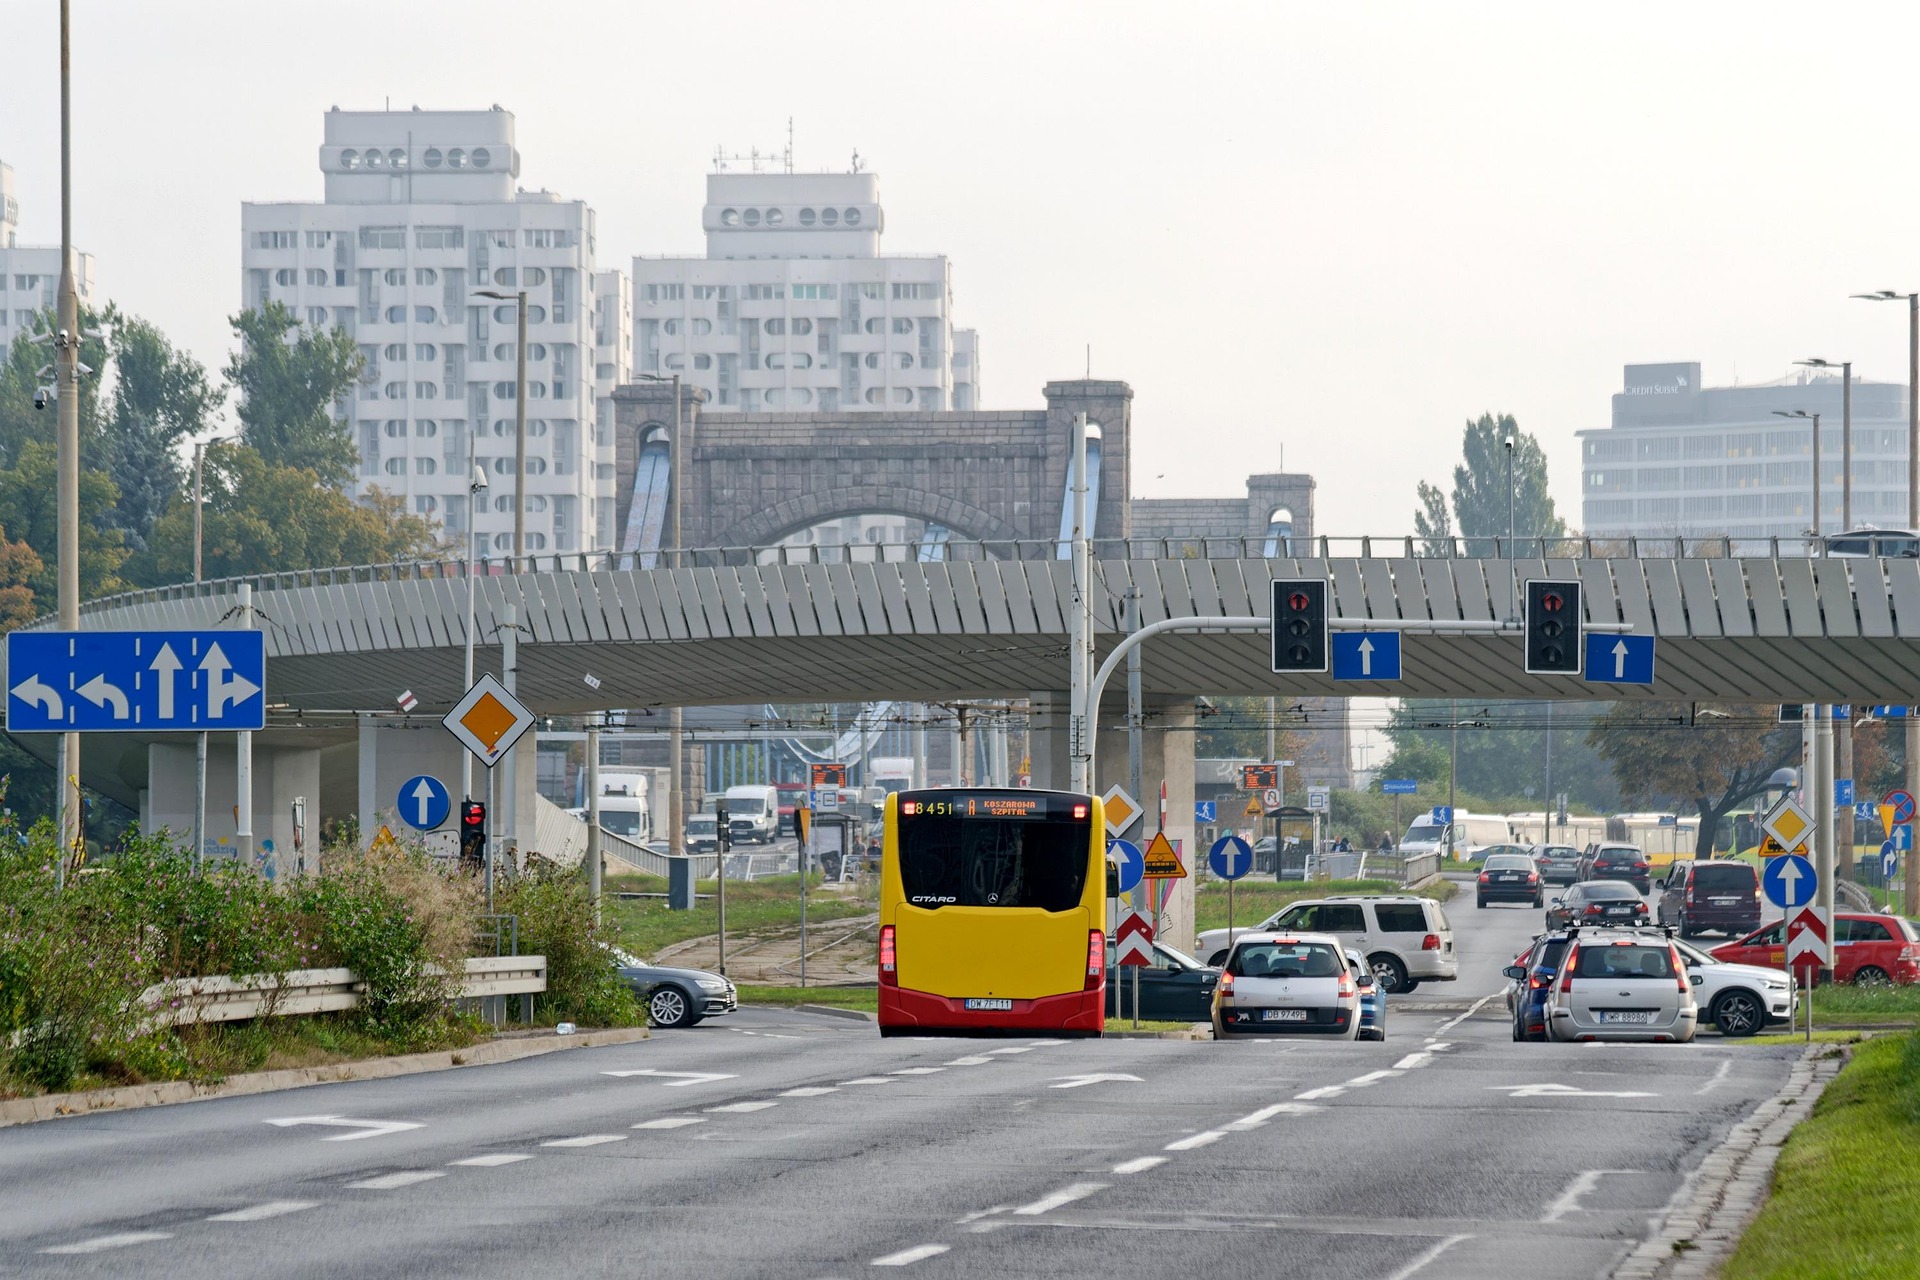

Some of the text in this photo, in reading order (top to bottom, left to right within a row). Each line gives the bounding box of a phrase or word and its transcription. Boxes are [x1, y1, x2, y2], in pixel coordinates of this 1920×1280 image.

[1624, 384, 1679, 396] CREDIT SUISSE
[915, 802, 952, 815] 8451
[968, 799, 976, 815] A
[984, 800, 1036, 808] KOSZAROWA
[911, 895, 957, 903] CITARO
[970, 999, 981, 1008] DW
[1267, 1010, 1305, 1019] DB 9749E
[1605, 1012, 1619, 1022] DWR
